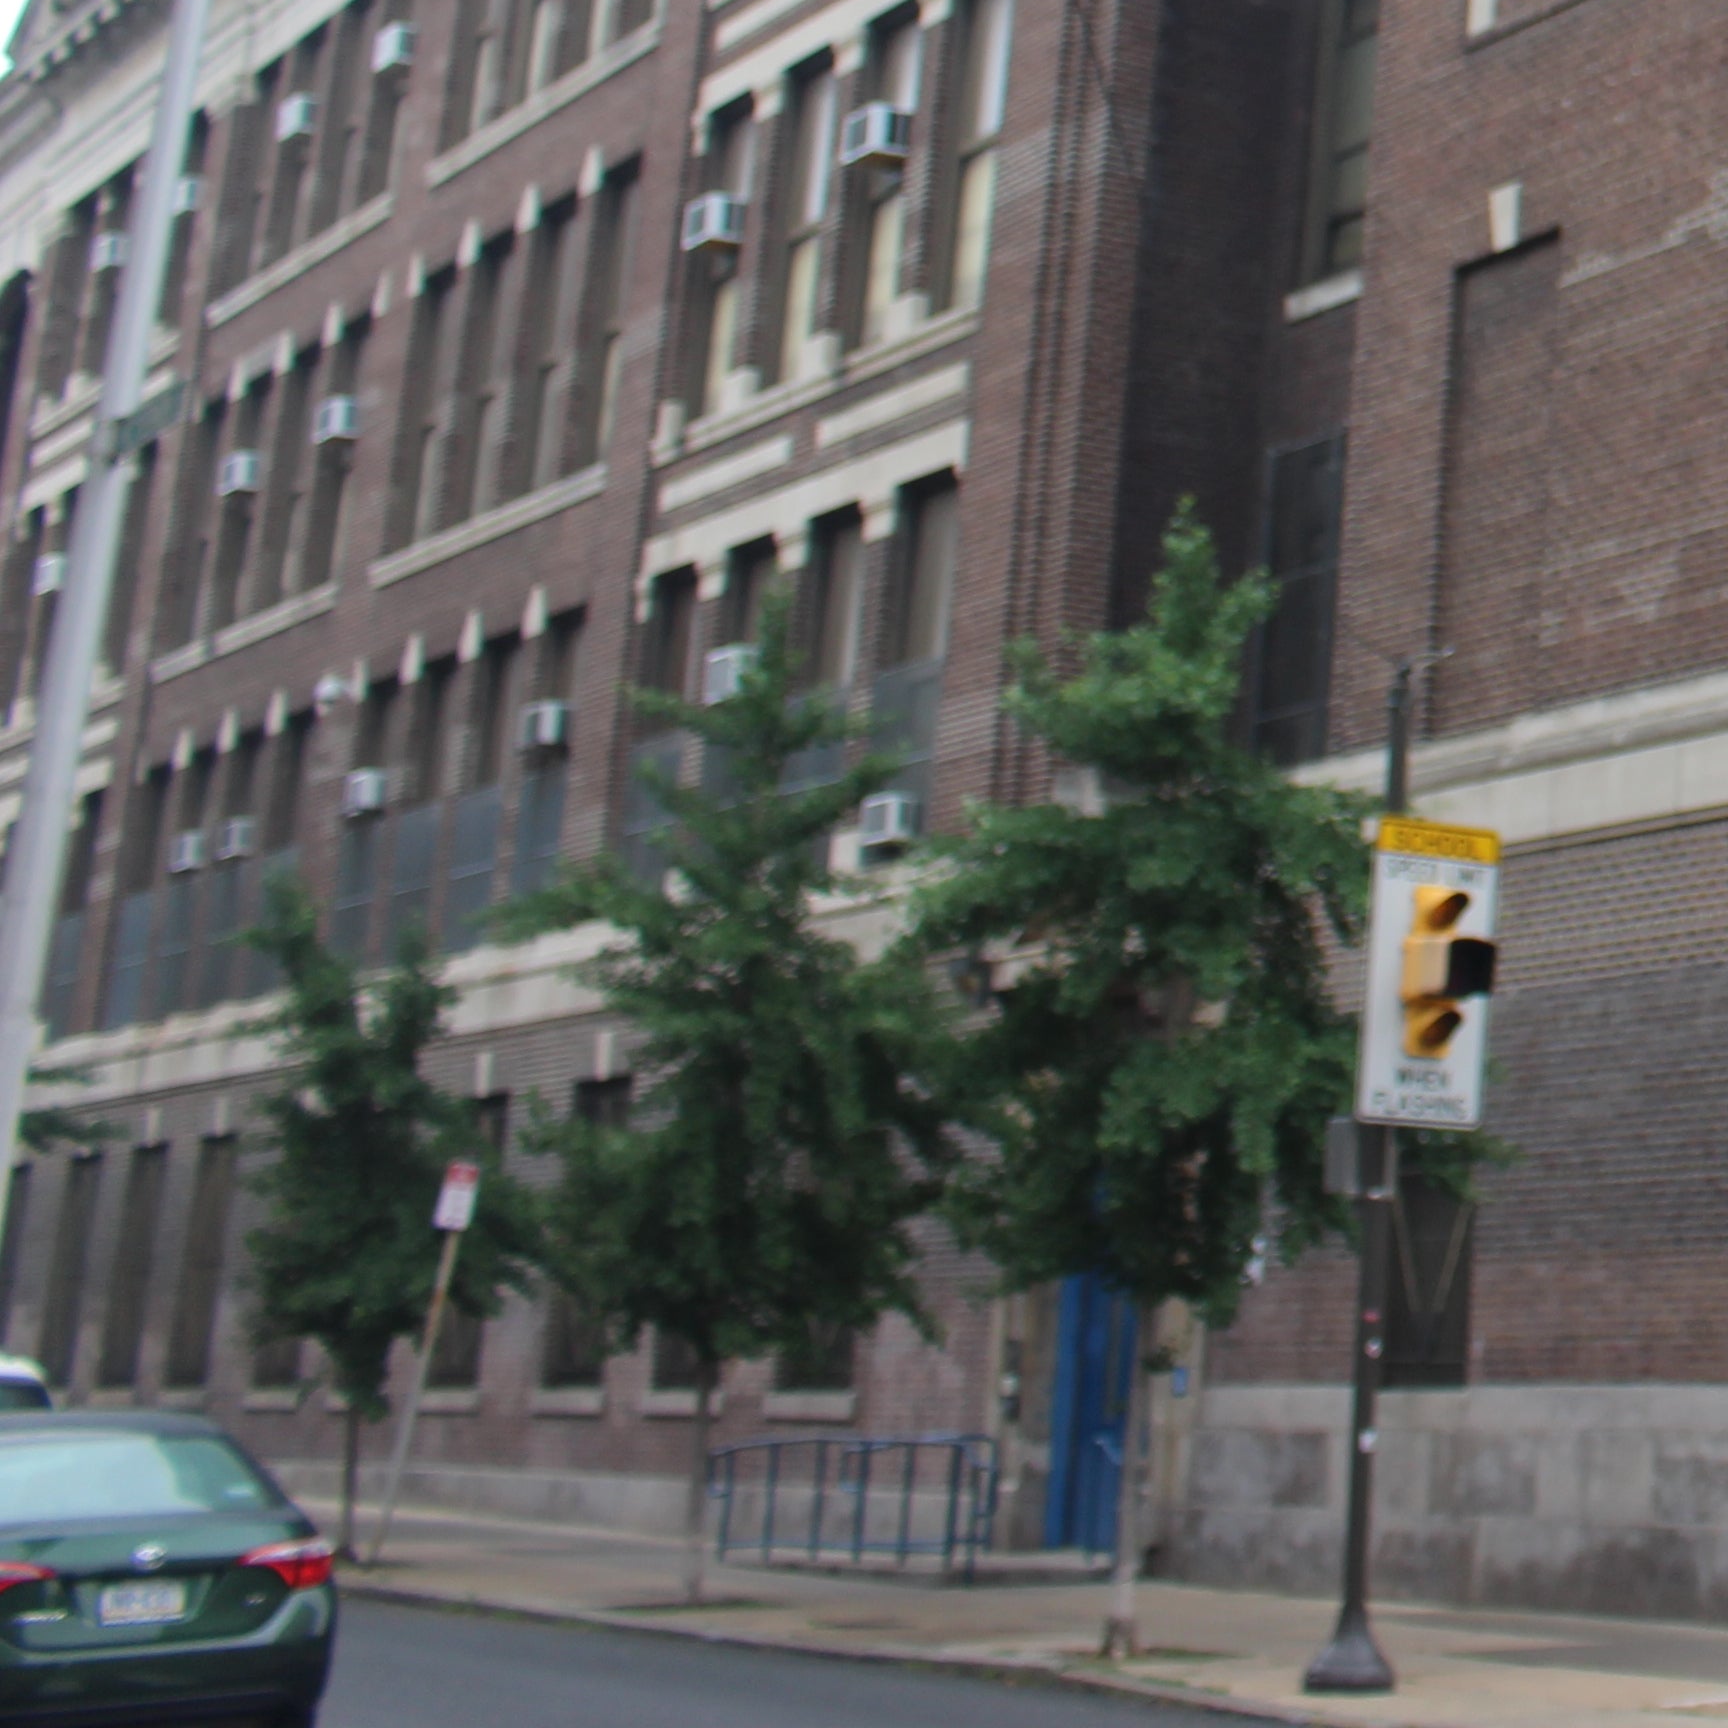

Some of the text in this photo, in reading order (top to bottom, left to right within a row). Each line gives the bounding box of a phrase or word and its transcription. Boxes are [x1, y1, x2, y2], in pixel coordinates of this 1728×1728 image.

[1394, 830, 1482, 860] SCHOOL
[1394, 1067, 1452, 1089] WHEN
[1372, 1090, 1468, 1120] FLASHING
